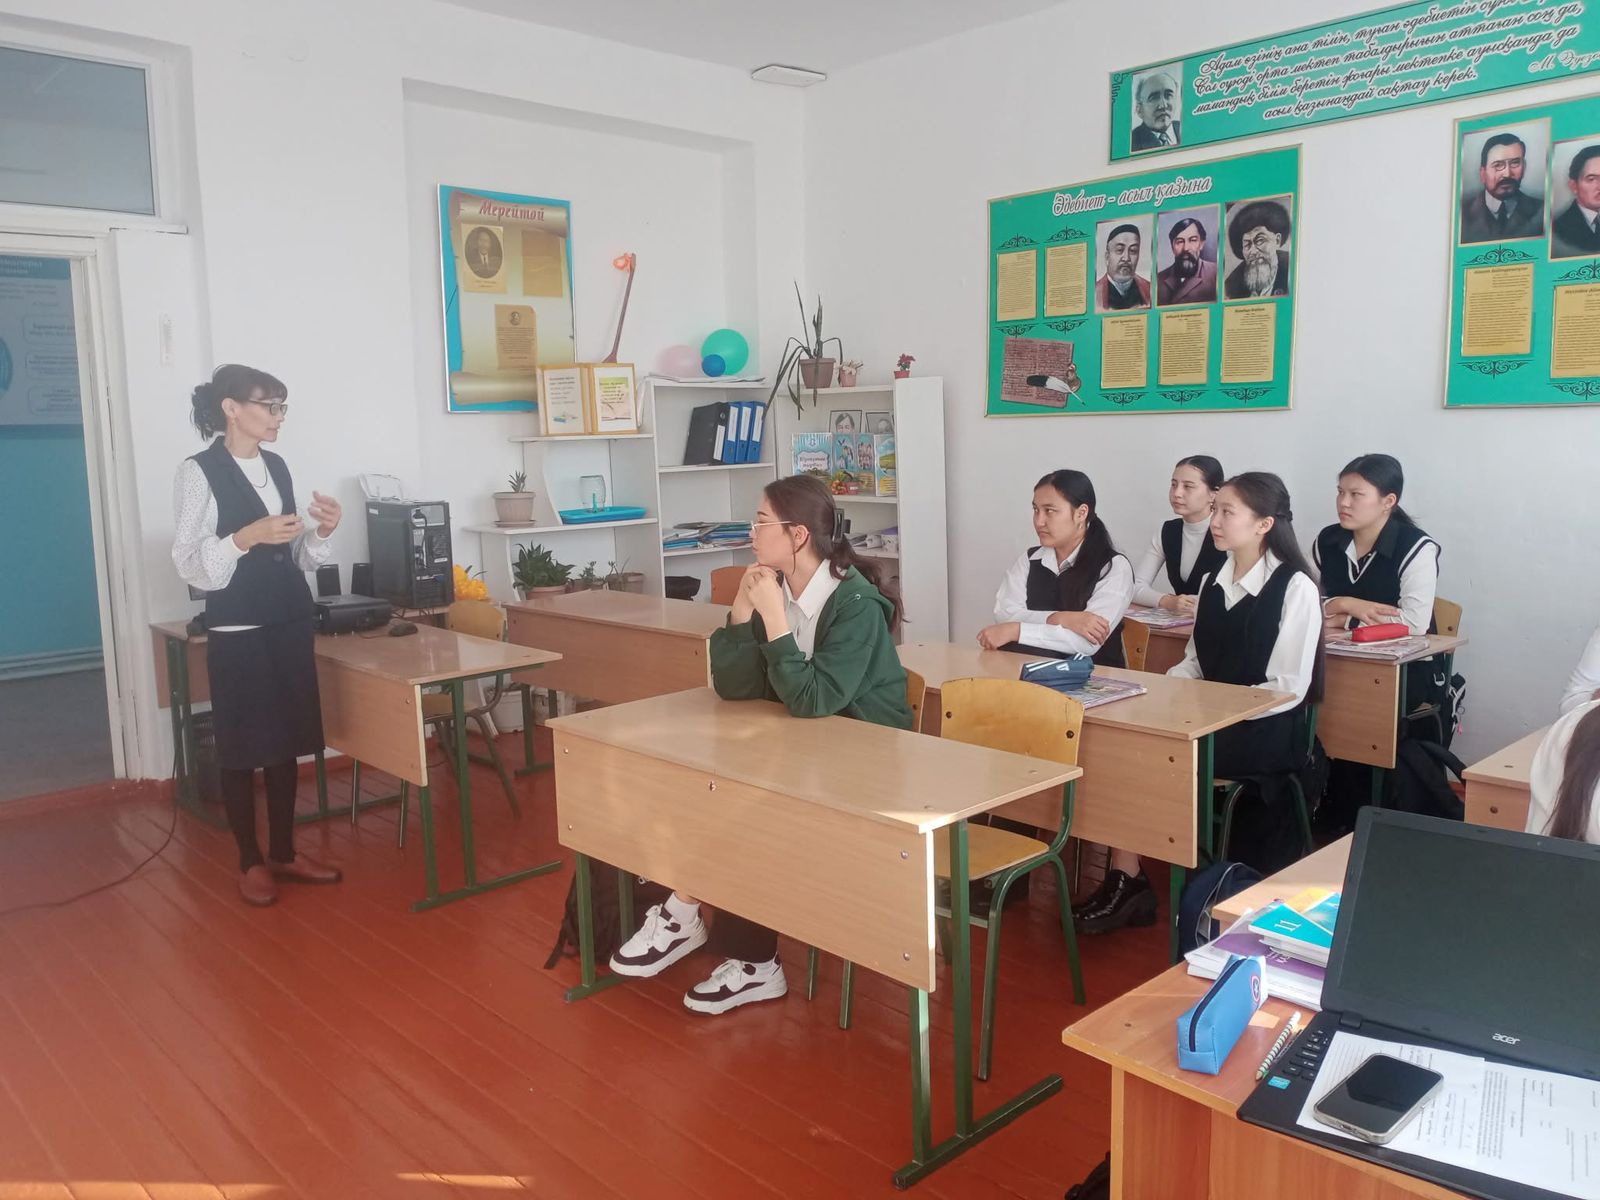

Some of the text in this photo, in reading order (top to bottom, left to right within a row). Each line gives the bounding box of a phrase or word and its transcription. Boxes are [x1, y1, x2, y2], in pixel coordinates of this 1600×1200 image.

[1194, 76, 1218, 95] Сол
[1256, 67, 1289, 86] орта
[1290, 58, 1340, 73] мектеп
[1343, 33, 1447, 61] табалдырығын
[1449, 16, 1524, 38] аттаған
[1527, 8, 1554, 22] соң
[1555, 3, 1582, 23] да,
[1200, 53, 1242, 77] Адам
[1244, 46, 1282, 70] өзінің
[1285, 43, 1309, 55] ана
[1311, 31, 1351, 49] тілін,
[1354, 22, 1401, 43] туған
[1403, 2, 1477, 34] әдебиетін
[1193, 26, 1579, 112] мамандық білім беретін жоғары мектепке ауысқанда да
[1529, 54, 1556, 72] М.
[1264, 106, 1293, 119] асыл
[1377, 80, 1431, 97] сақтау
[1433, 66, 1478, 90] керек.
[479, 199, 545, 222] Мерейтой
[1053, 189, 1106, 215] Әдебиет
[1118, 188, 1152, 205] асыл
[1155, 177, 1212, 206] қазына
[1491, 1032, 1521, 1045] acer
